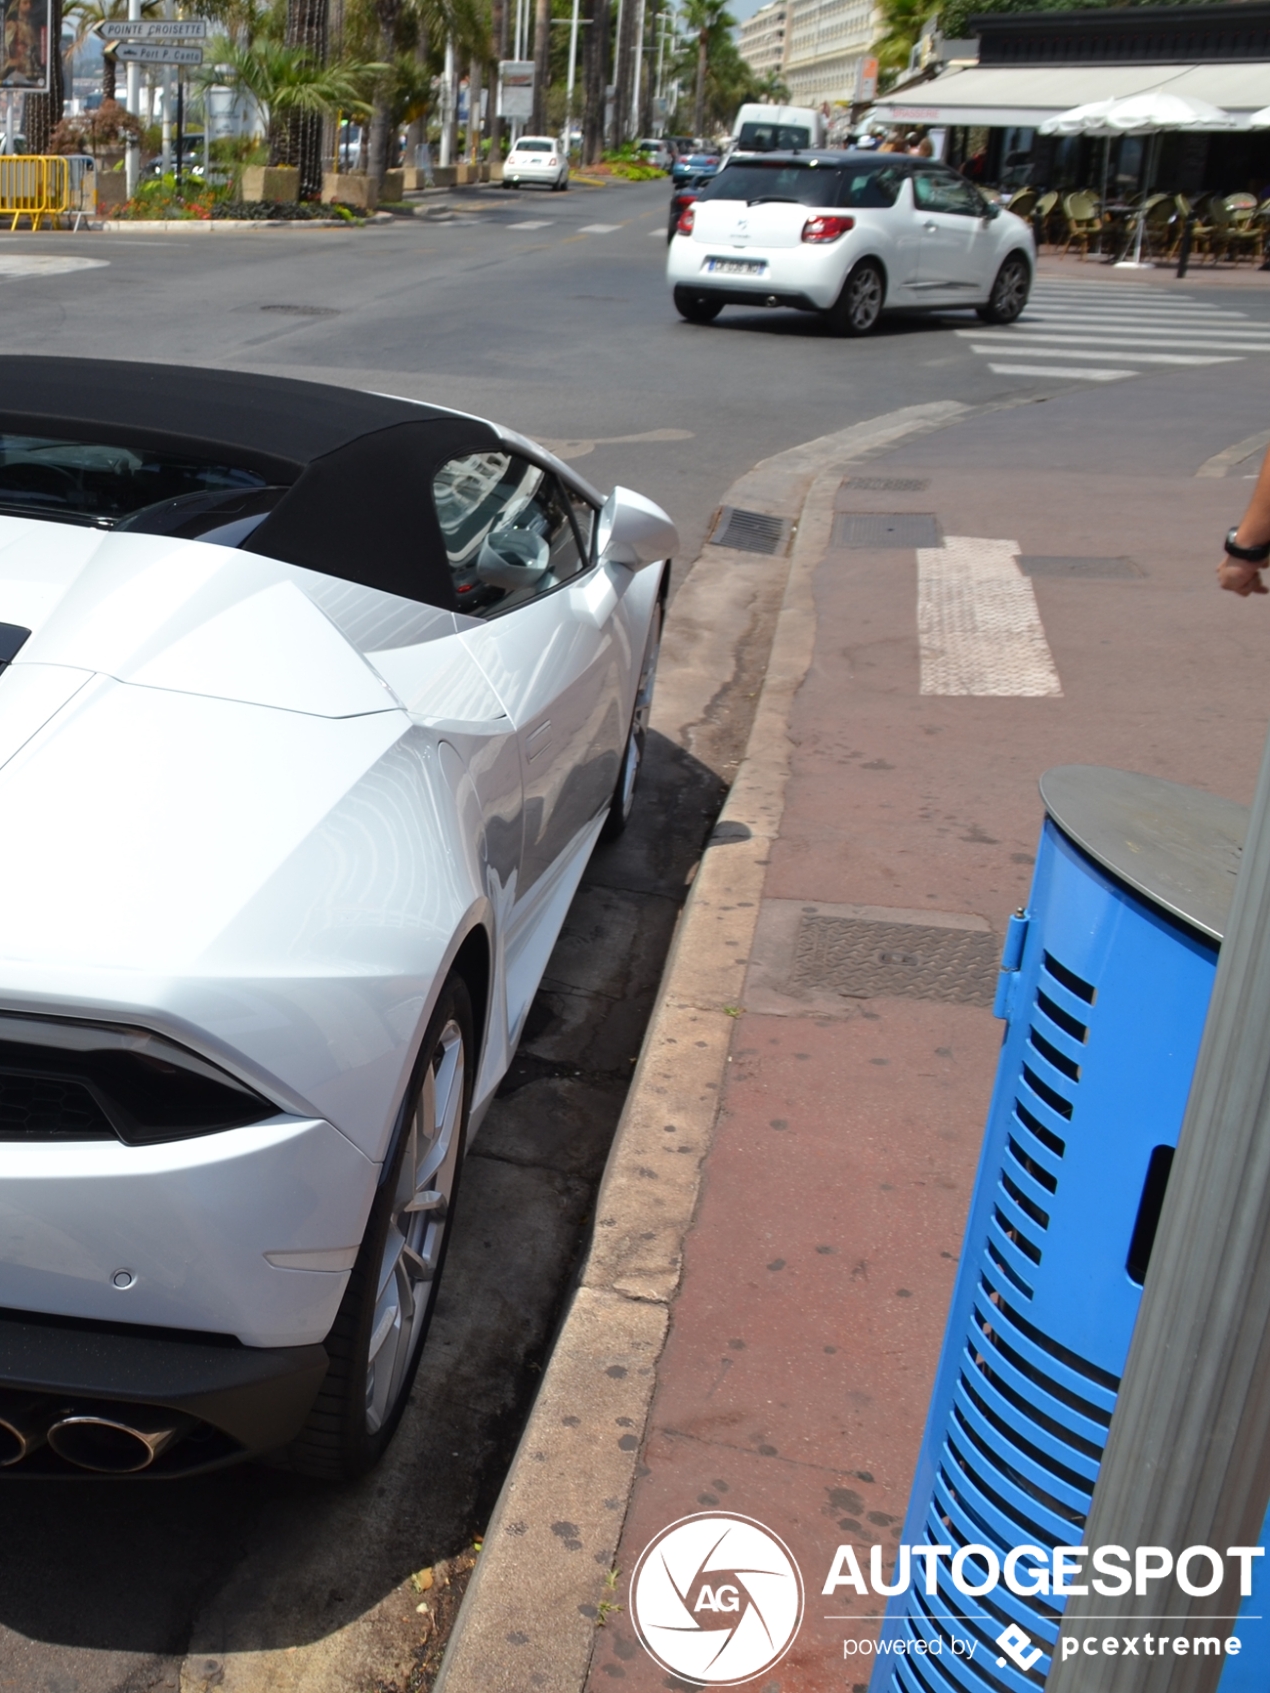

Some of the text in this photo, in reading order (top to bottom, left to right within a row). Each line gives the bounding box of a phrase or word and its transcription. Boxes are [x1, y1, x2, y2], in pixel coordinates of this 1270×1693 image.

[107, 24, 202, 35] POINTE CROISETTE
[140, 48, 158, 59] Port
[174, 50, 200, 61] Canto
[892, 109, 939, 119] BRASSERIE
